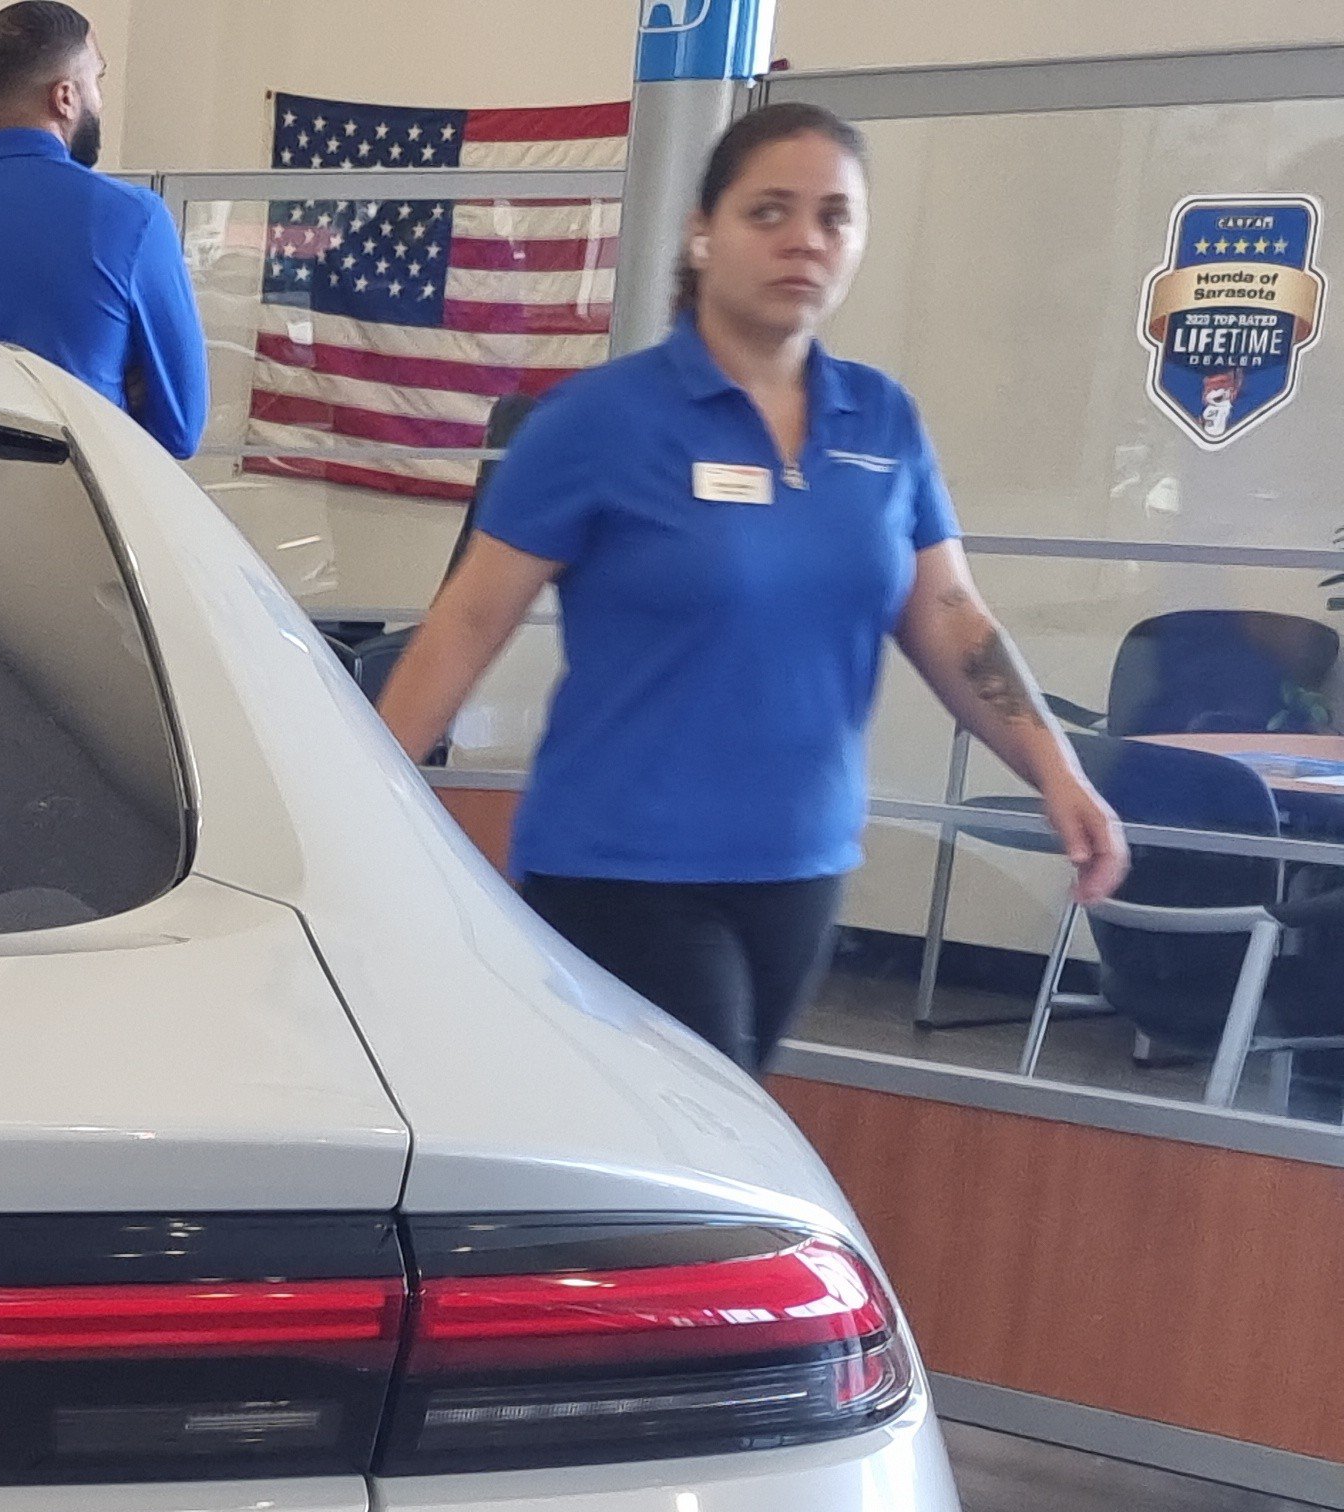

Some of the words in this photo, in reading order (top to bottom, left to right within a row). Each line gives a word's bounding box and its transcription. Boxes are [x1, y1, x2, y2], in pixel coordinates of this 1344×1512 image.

[1196, 271, 1254, 285] Honda
[1259, 272, 1279, 286] of
[1194, 287, 1277, 301] Sarasota
[1173, 328, 1284, 355] LIFETIME
[1189, 355, 1262, 367] DEALER
